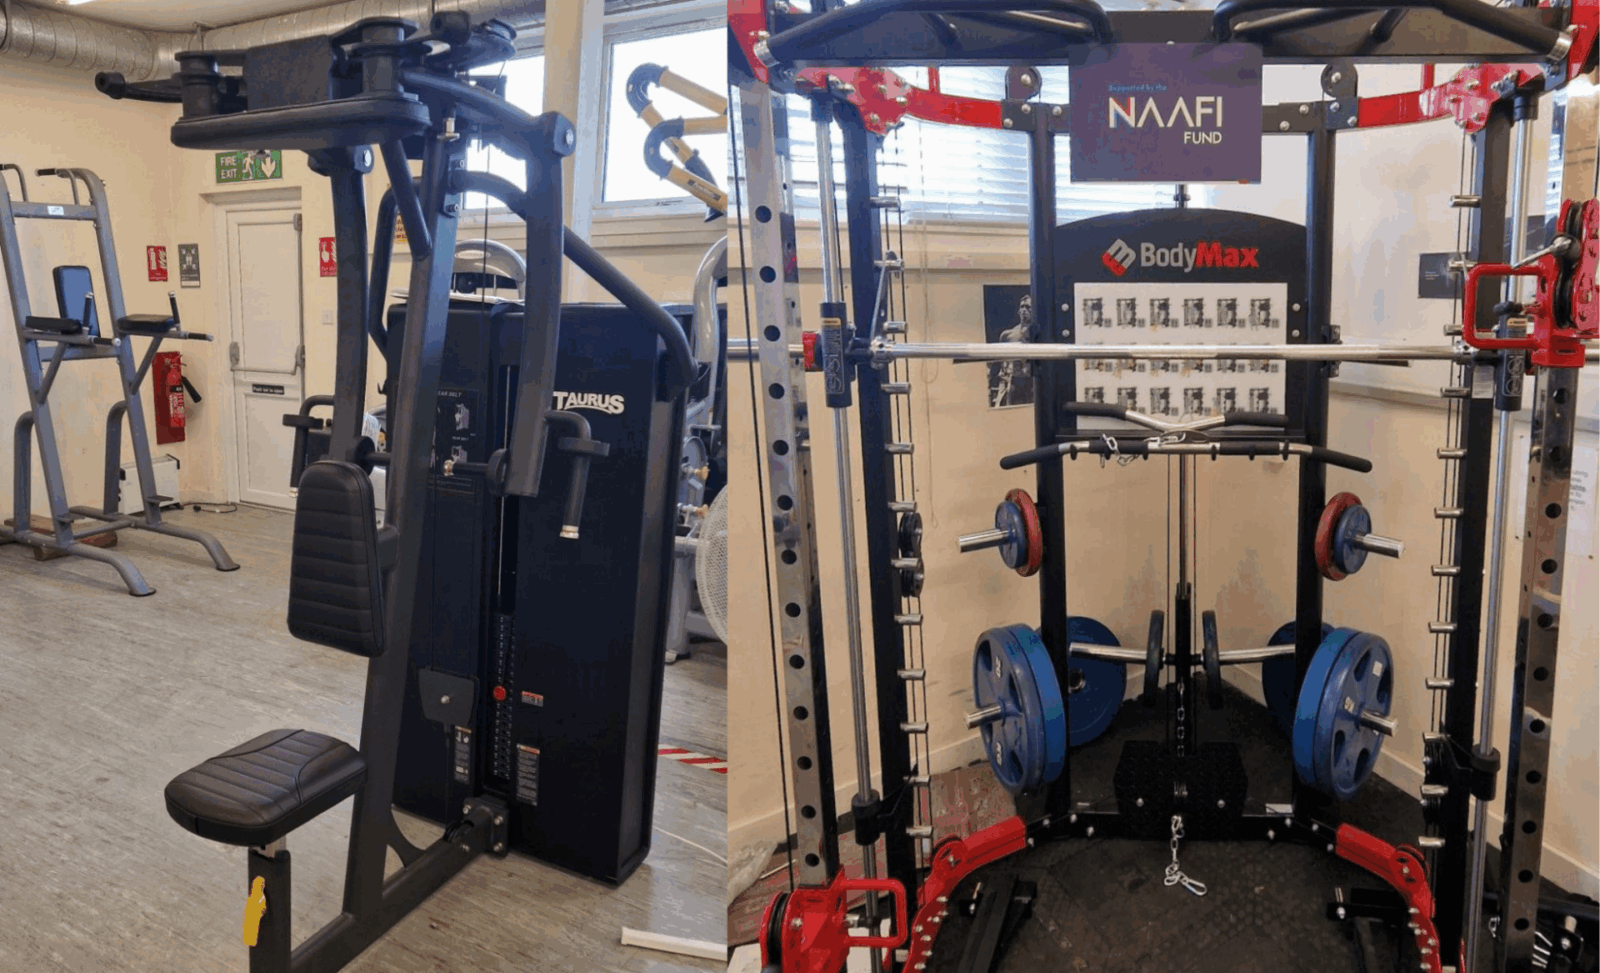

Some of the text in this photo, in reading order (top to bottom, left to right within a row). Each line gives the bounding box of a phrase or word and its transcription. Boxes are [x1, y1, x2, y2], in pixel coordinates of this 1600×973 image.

[1108, 96, 1223, 128] NAAFI
[1183, 131, 1222, 144] FUND
[220, 156, 237, 166] FIRE
[221, 168, 237, 179] EXIT
[1140, 242, 1258, 273] BodyMax
[553, 391, 625, 414] TAURUS
